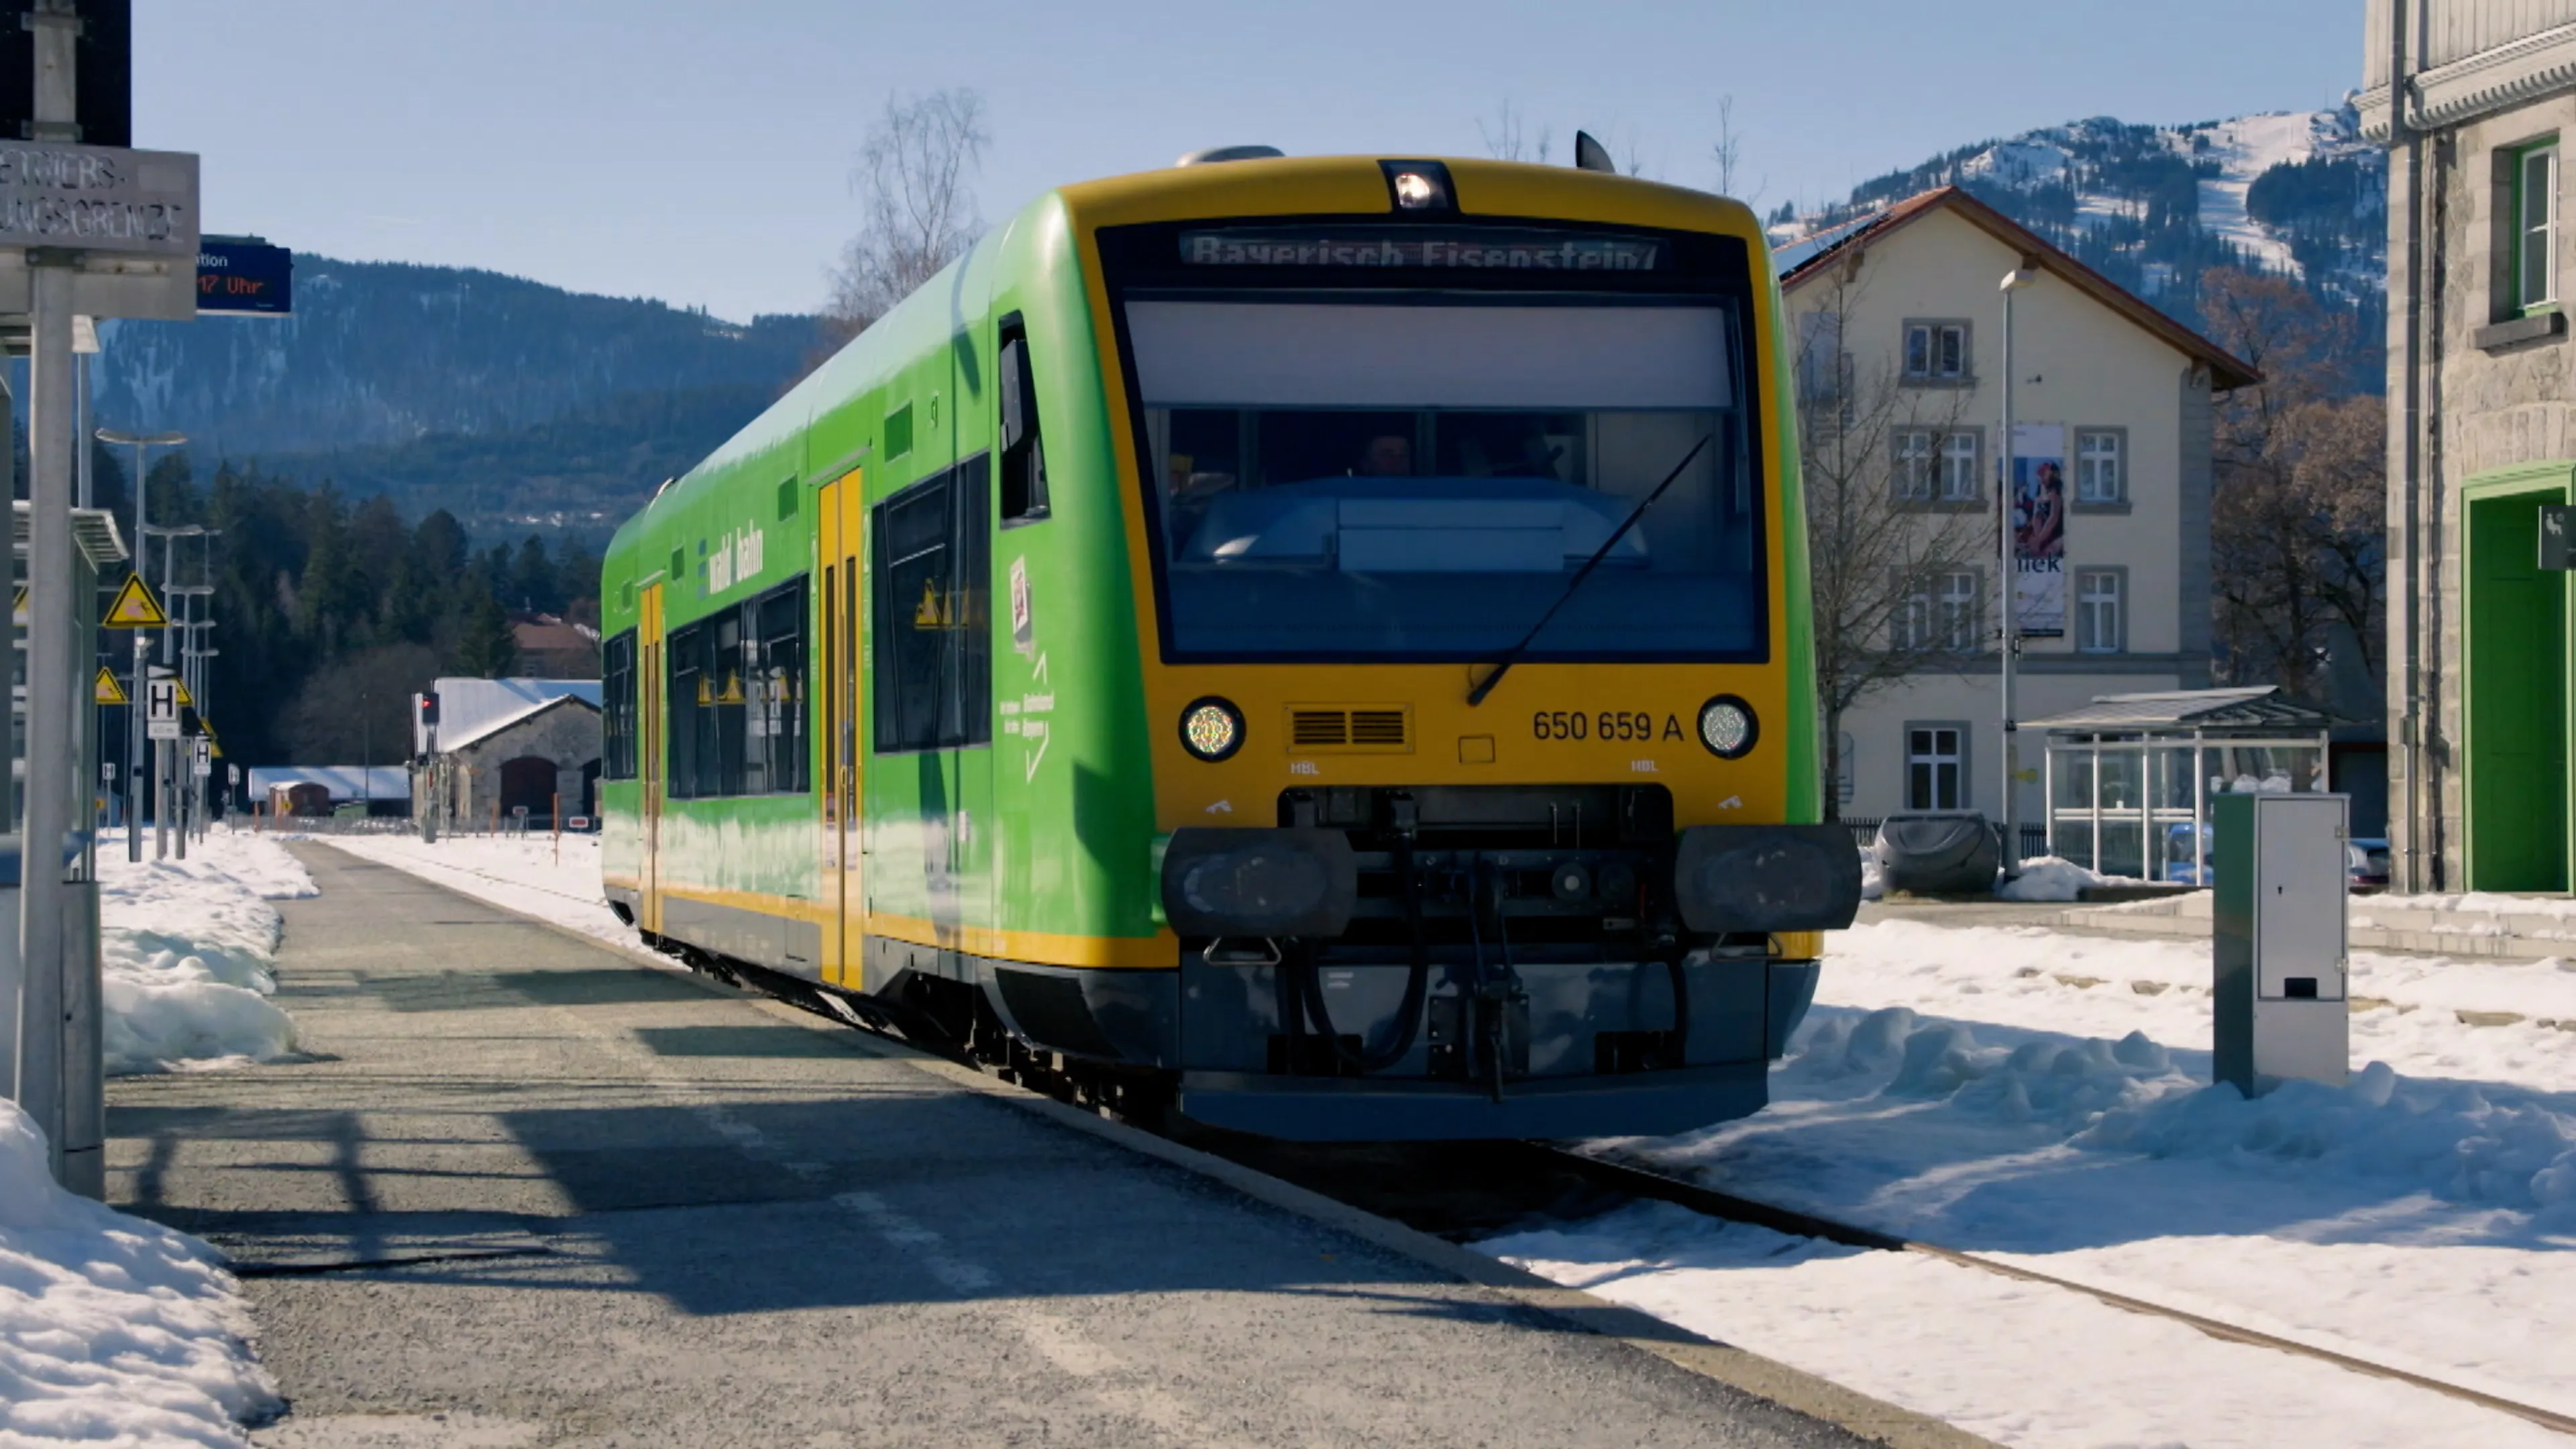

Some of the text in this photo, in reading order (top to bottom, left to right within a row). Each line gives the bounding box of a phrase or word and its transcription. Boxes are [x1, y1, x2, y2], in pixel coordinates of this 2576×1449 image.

[151, 685, 173, 718] H
[1534, 711, 1684, 743] 650 659 A
